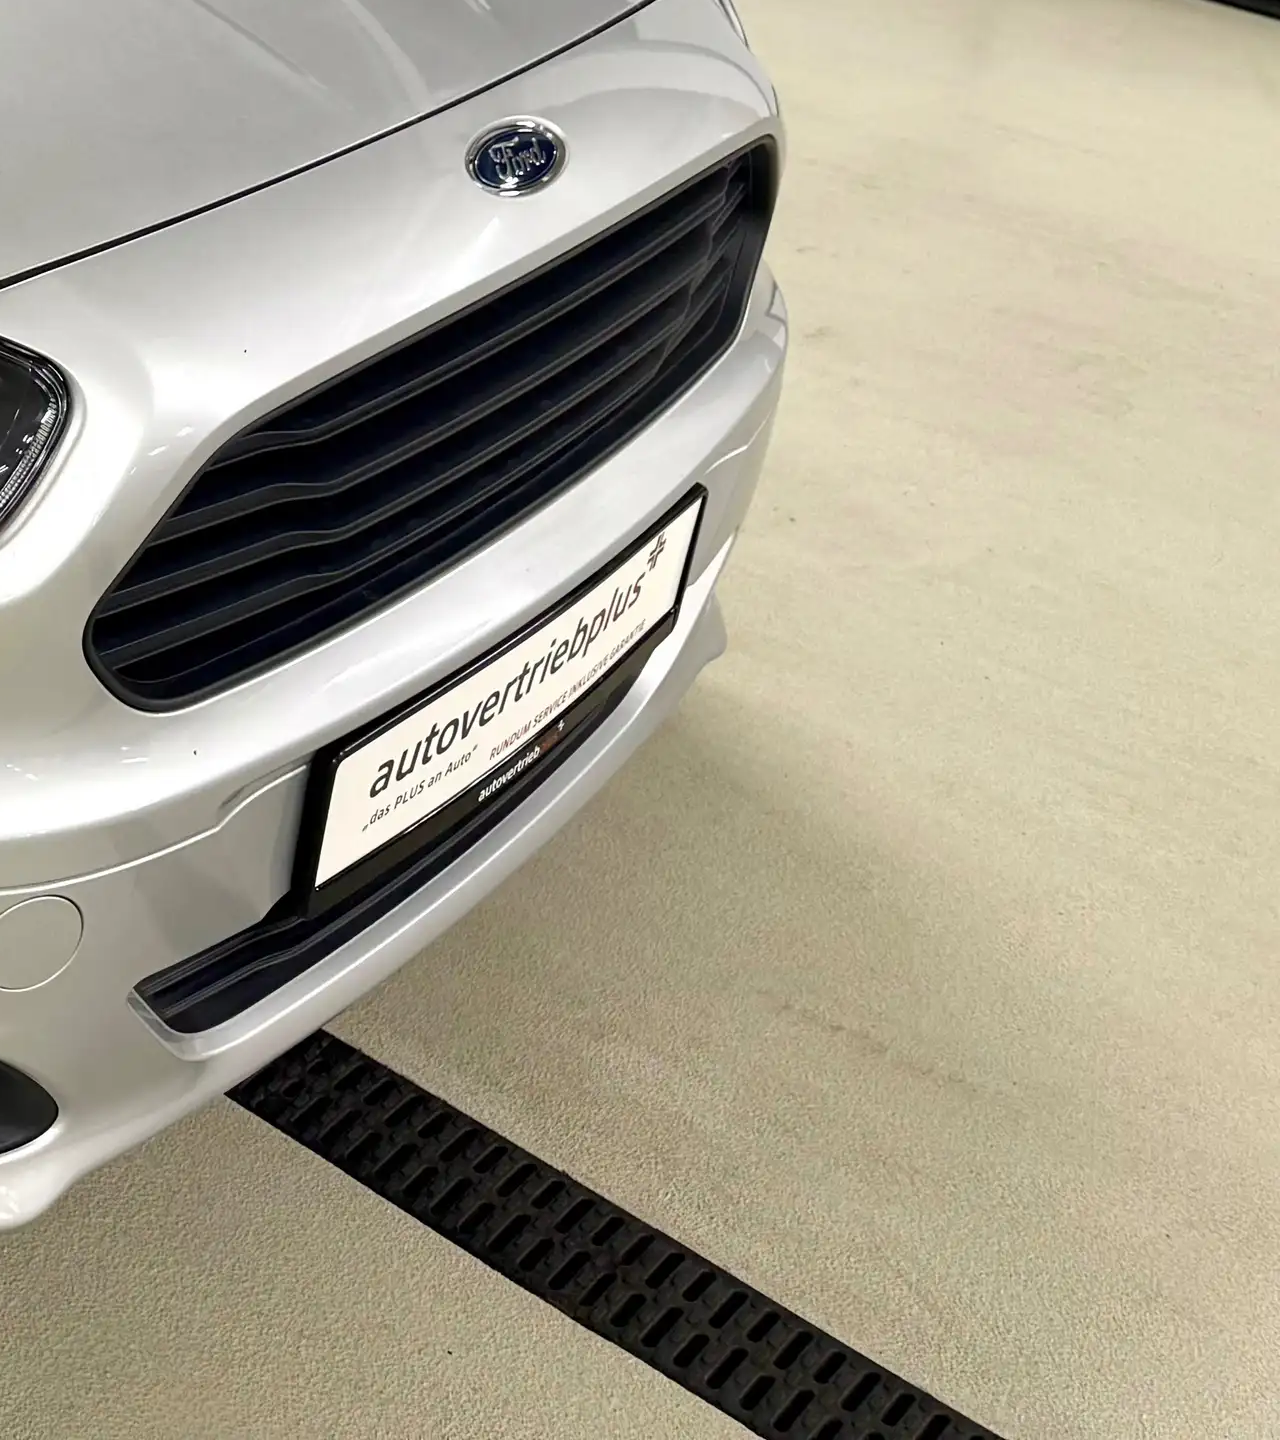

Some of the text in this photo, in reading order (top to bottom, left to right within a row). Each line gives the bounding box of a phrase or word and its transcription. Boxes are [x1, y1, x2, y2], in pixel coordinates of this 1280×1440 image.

[487, 136, 547, 183] Ford
[369, 571, 646, 799] autovertriebplus
[489, 720, 532, 761] RUNDUM
[532, 690, 568, 729] SERVICE
[394, 779, 426, 810] PLUS
[427, 771, 443, 788] an
[477, 728, 560, 802] autovertrieb
